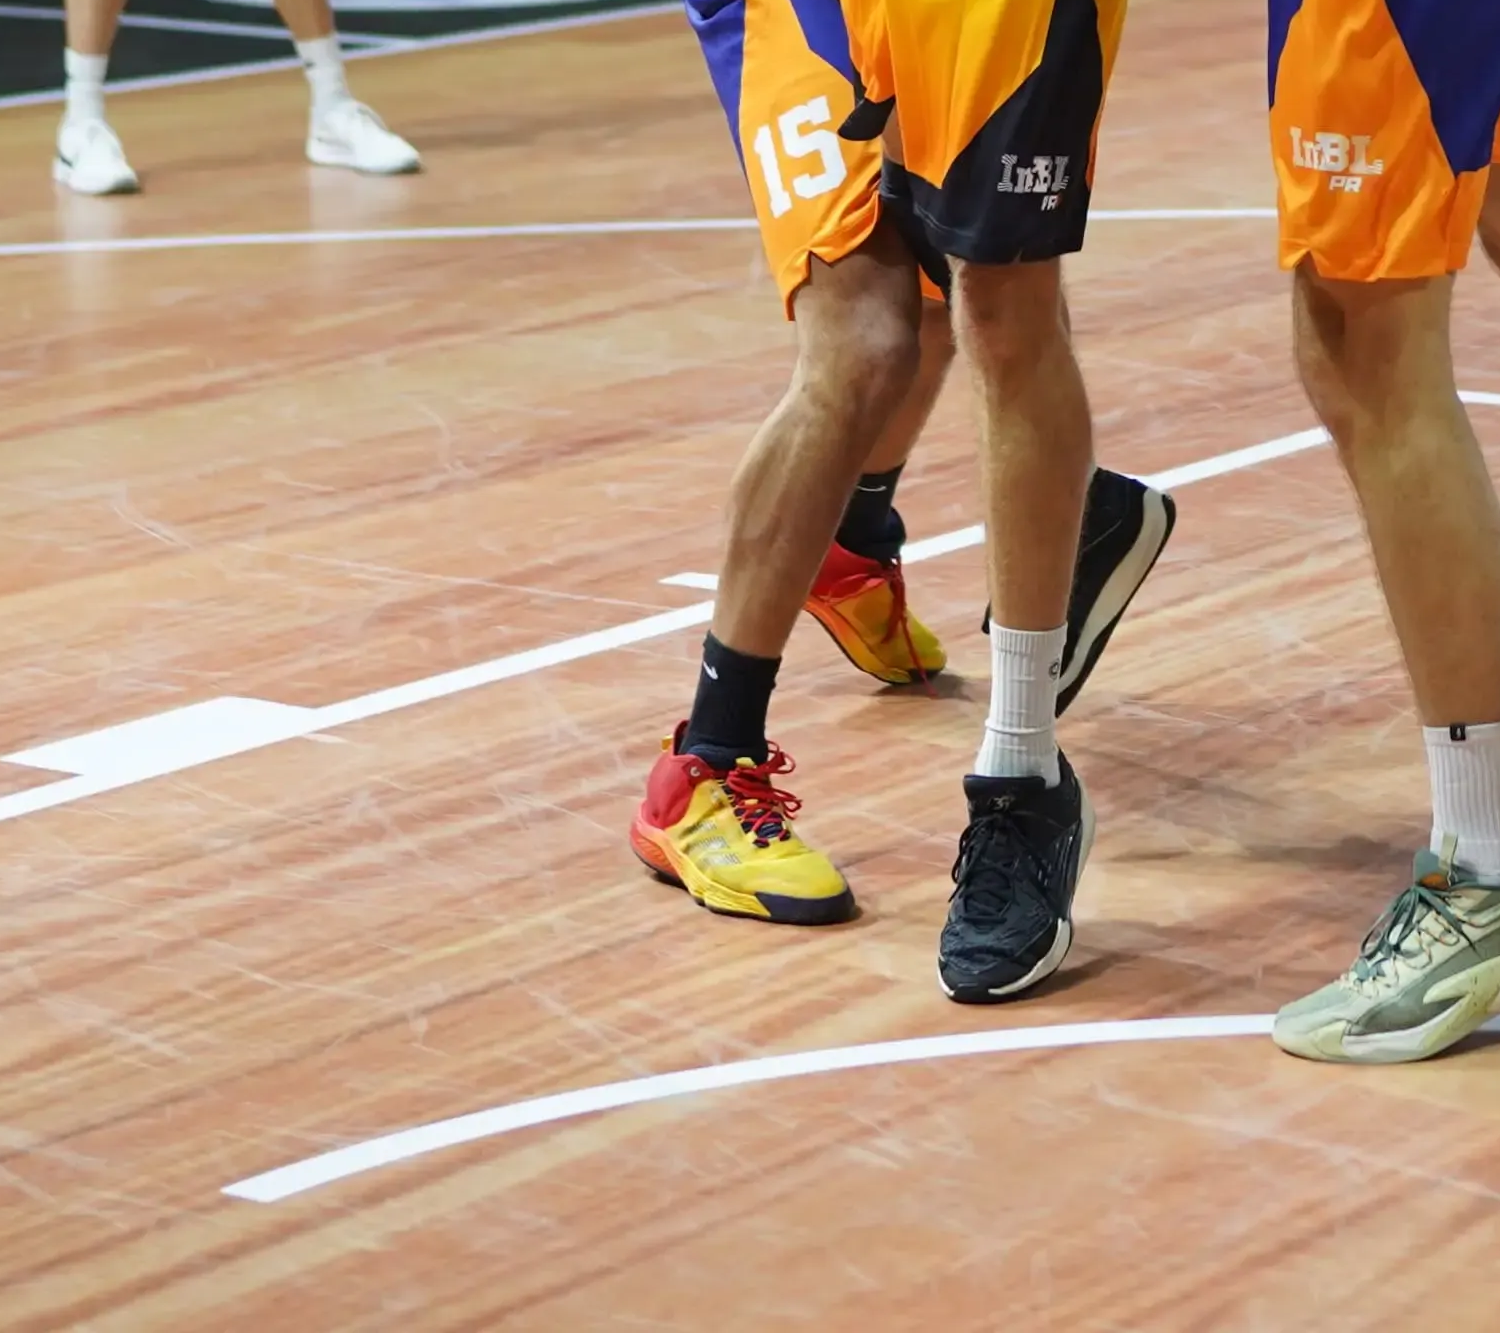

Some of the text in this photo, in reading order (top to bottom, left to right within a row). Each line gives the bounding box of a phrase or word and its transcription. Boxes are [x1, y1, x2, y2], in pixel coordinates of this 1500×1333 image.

[754, 95, 847, 218] 15
[997, 153, 1070, 194] InBL
[1289, 126, 1384, 175] InBL
